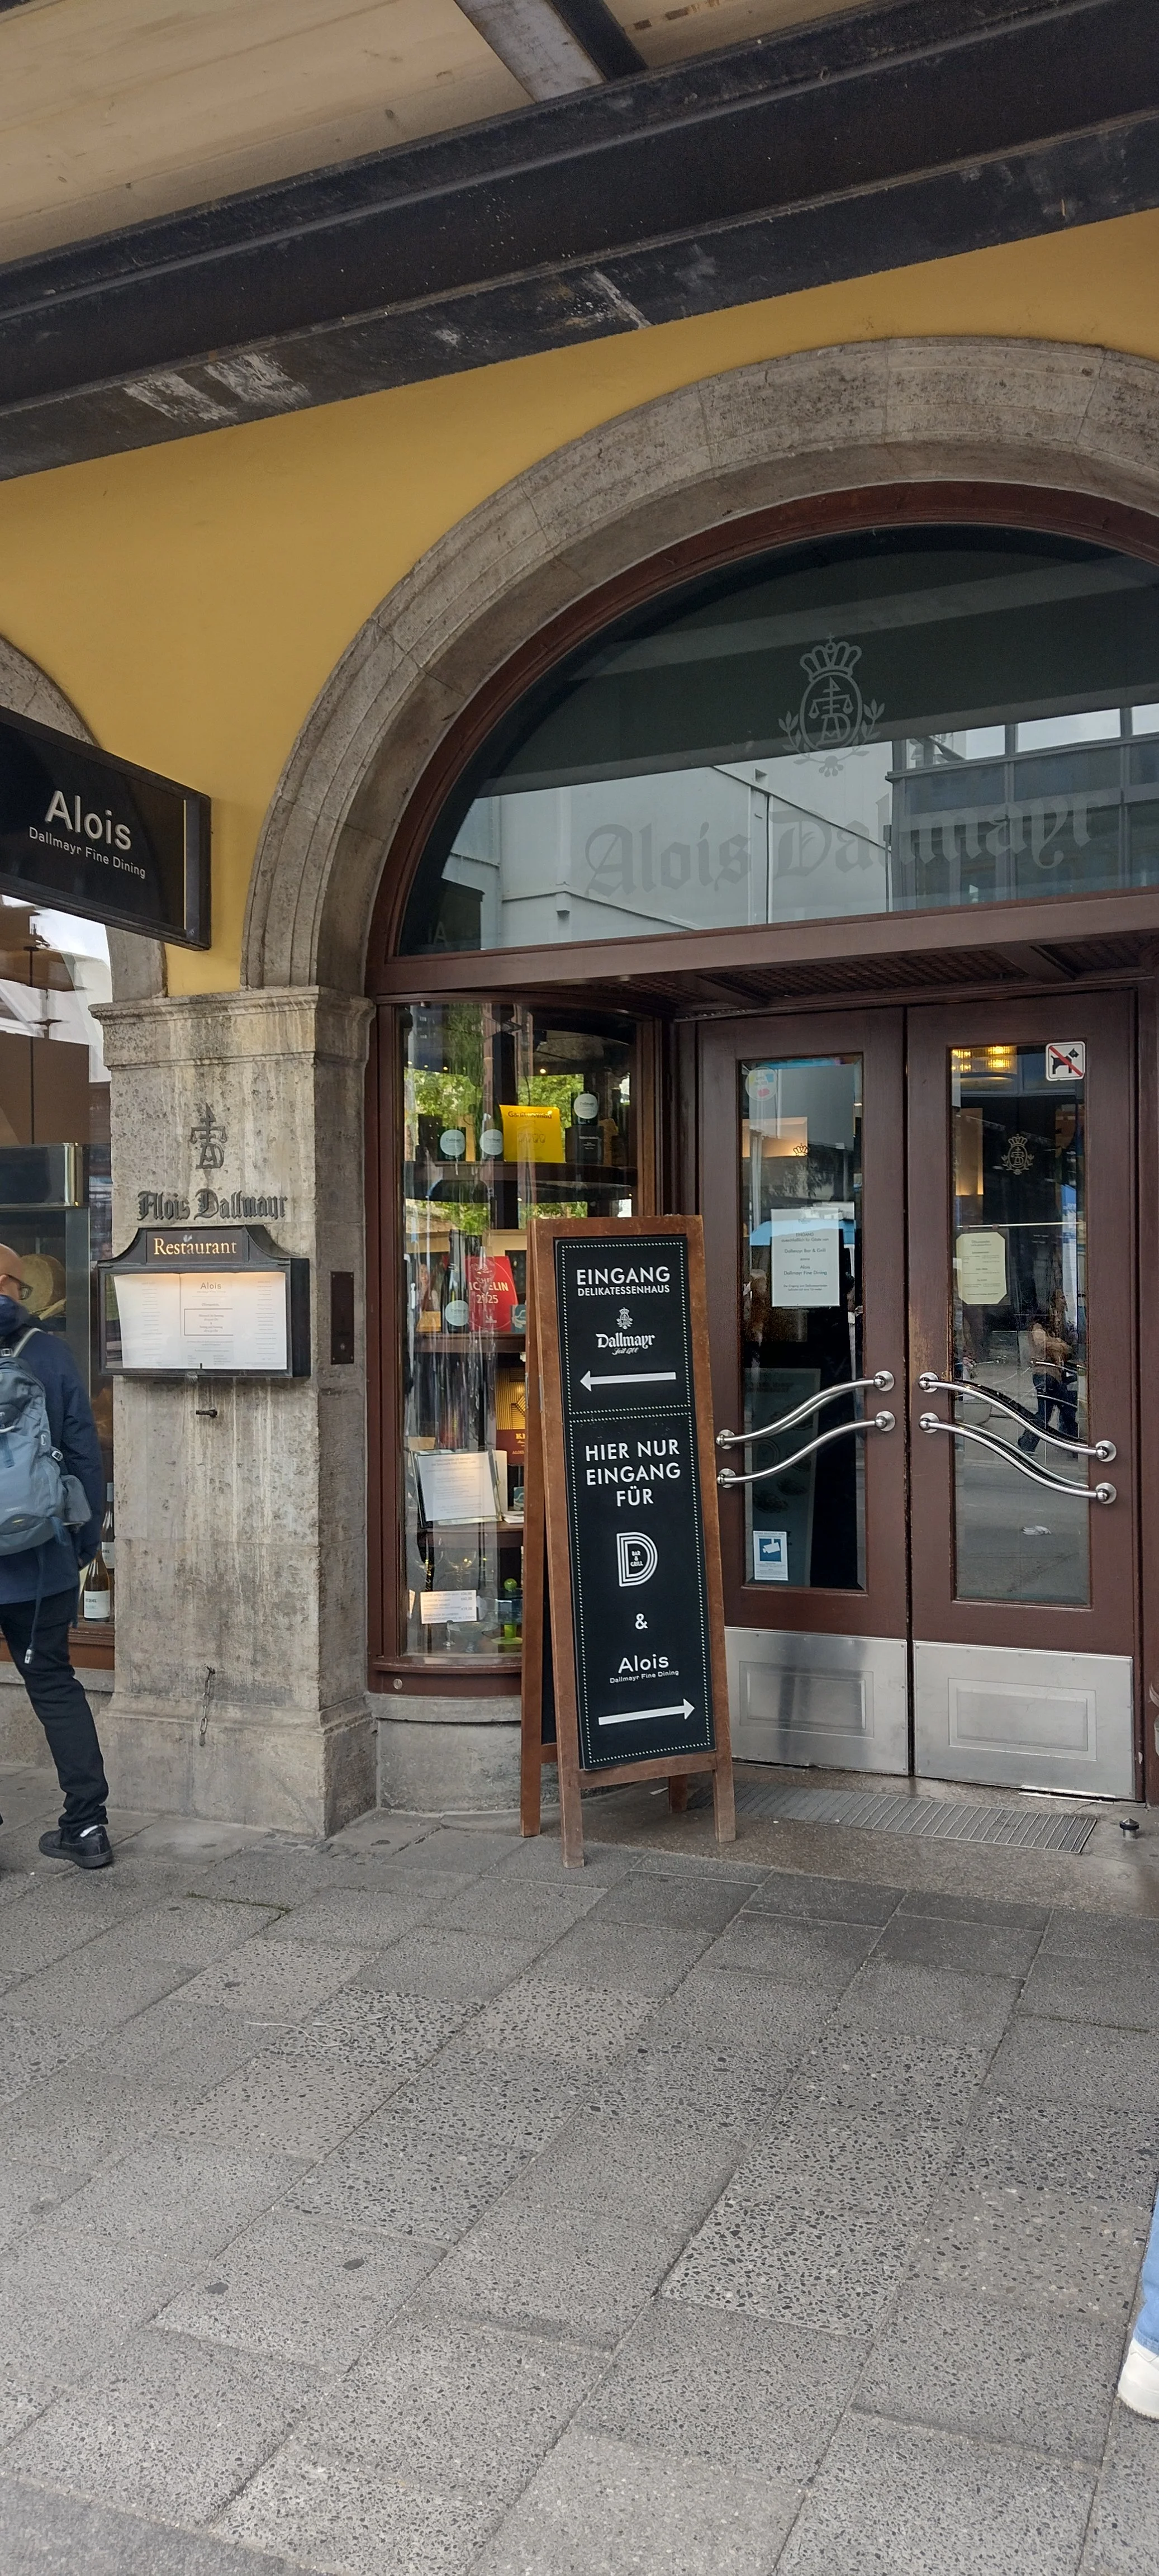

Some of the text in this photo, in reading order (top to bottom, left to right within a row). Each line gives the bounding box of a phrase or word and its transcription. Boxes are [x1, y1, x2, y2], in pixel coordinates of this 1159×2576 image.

[45, 790, 132, 850] Alois
[29, 826, 146, 879] Dallmayr Fine Dining
[585, 821, 752, 898] Alois
[137, 1188, 288, 1220] Alois Dallmayr
[154, 1237, 237, 1255] Restaurant
[577, 1266, 671, 1285] EINGANG
[577, 1284, 671, 1296] DELIKATESSENHAUS
[596, 1332, 656, 1349] Dallmayr
[585, 1439, 680, 1461] HIER NUR
[586, 1462, 681, 1485] EINGANG
[616, 1485, 654, 1507] FÜR
[616, 1532, 658, 1587] D
[635, 1613, 649, 1630] &
[618, 1654, 669, 1674] Alois
[610, 1675, 640, 1684] Dallmayr
